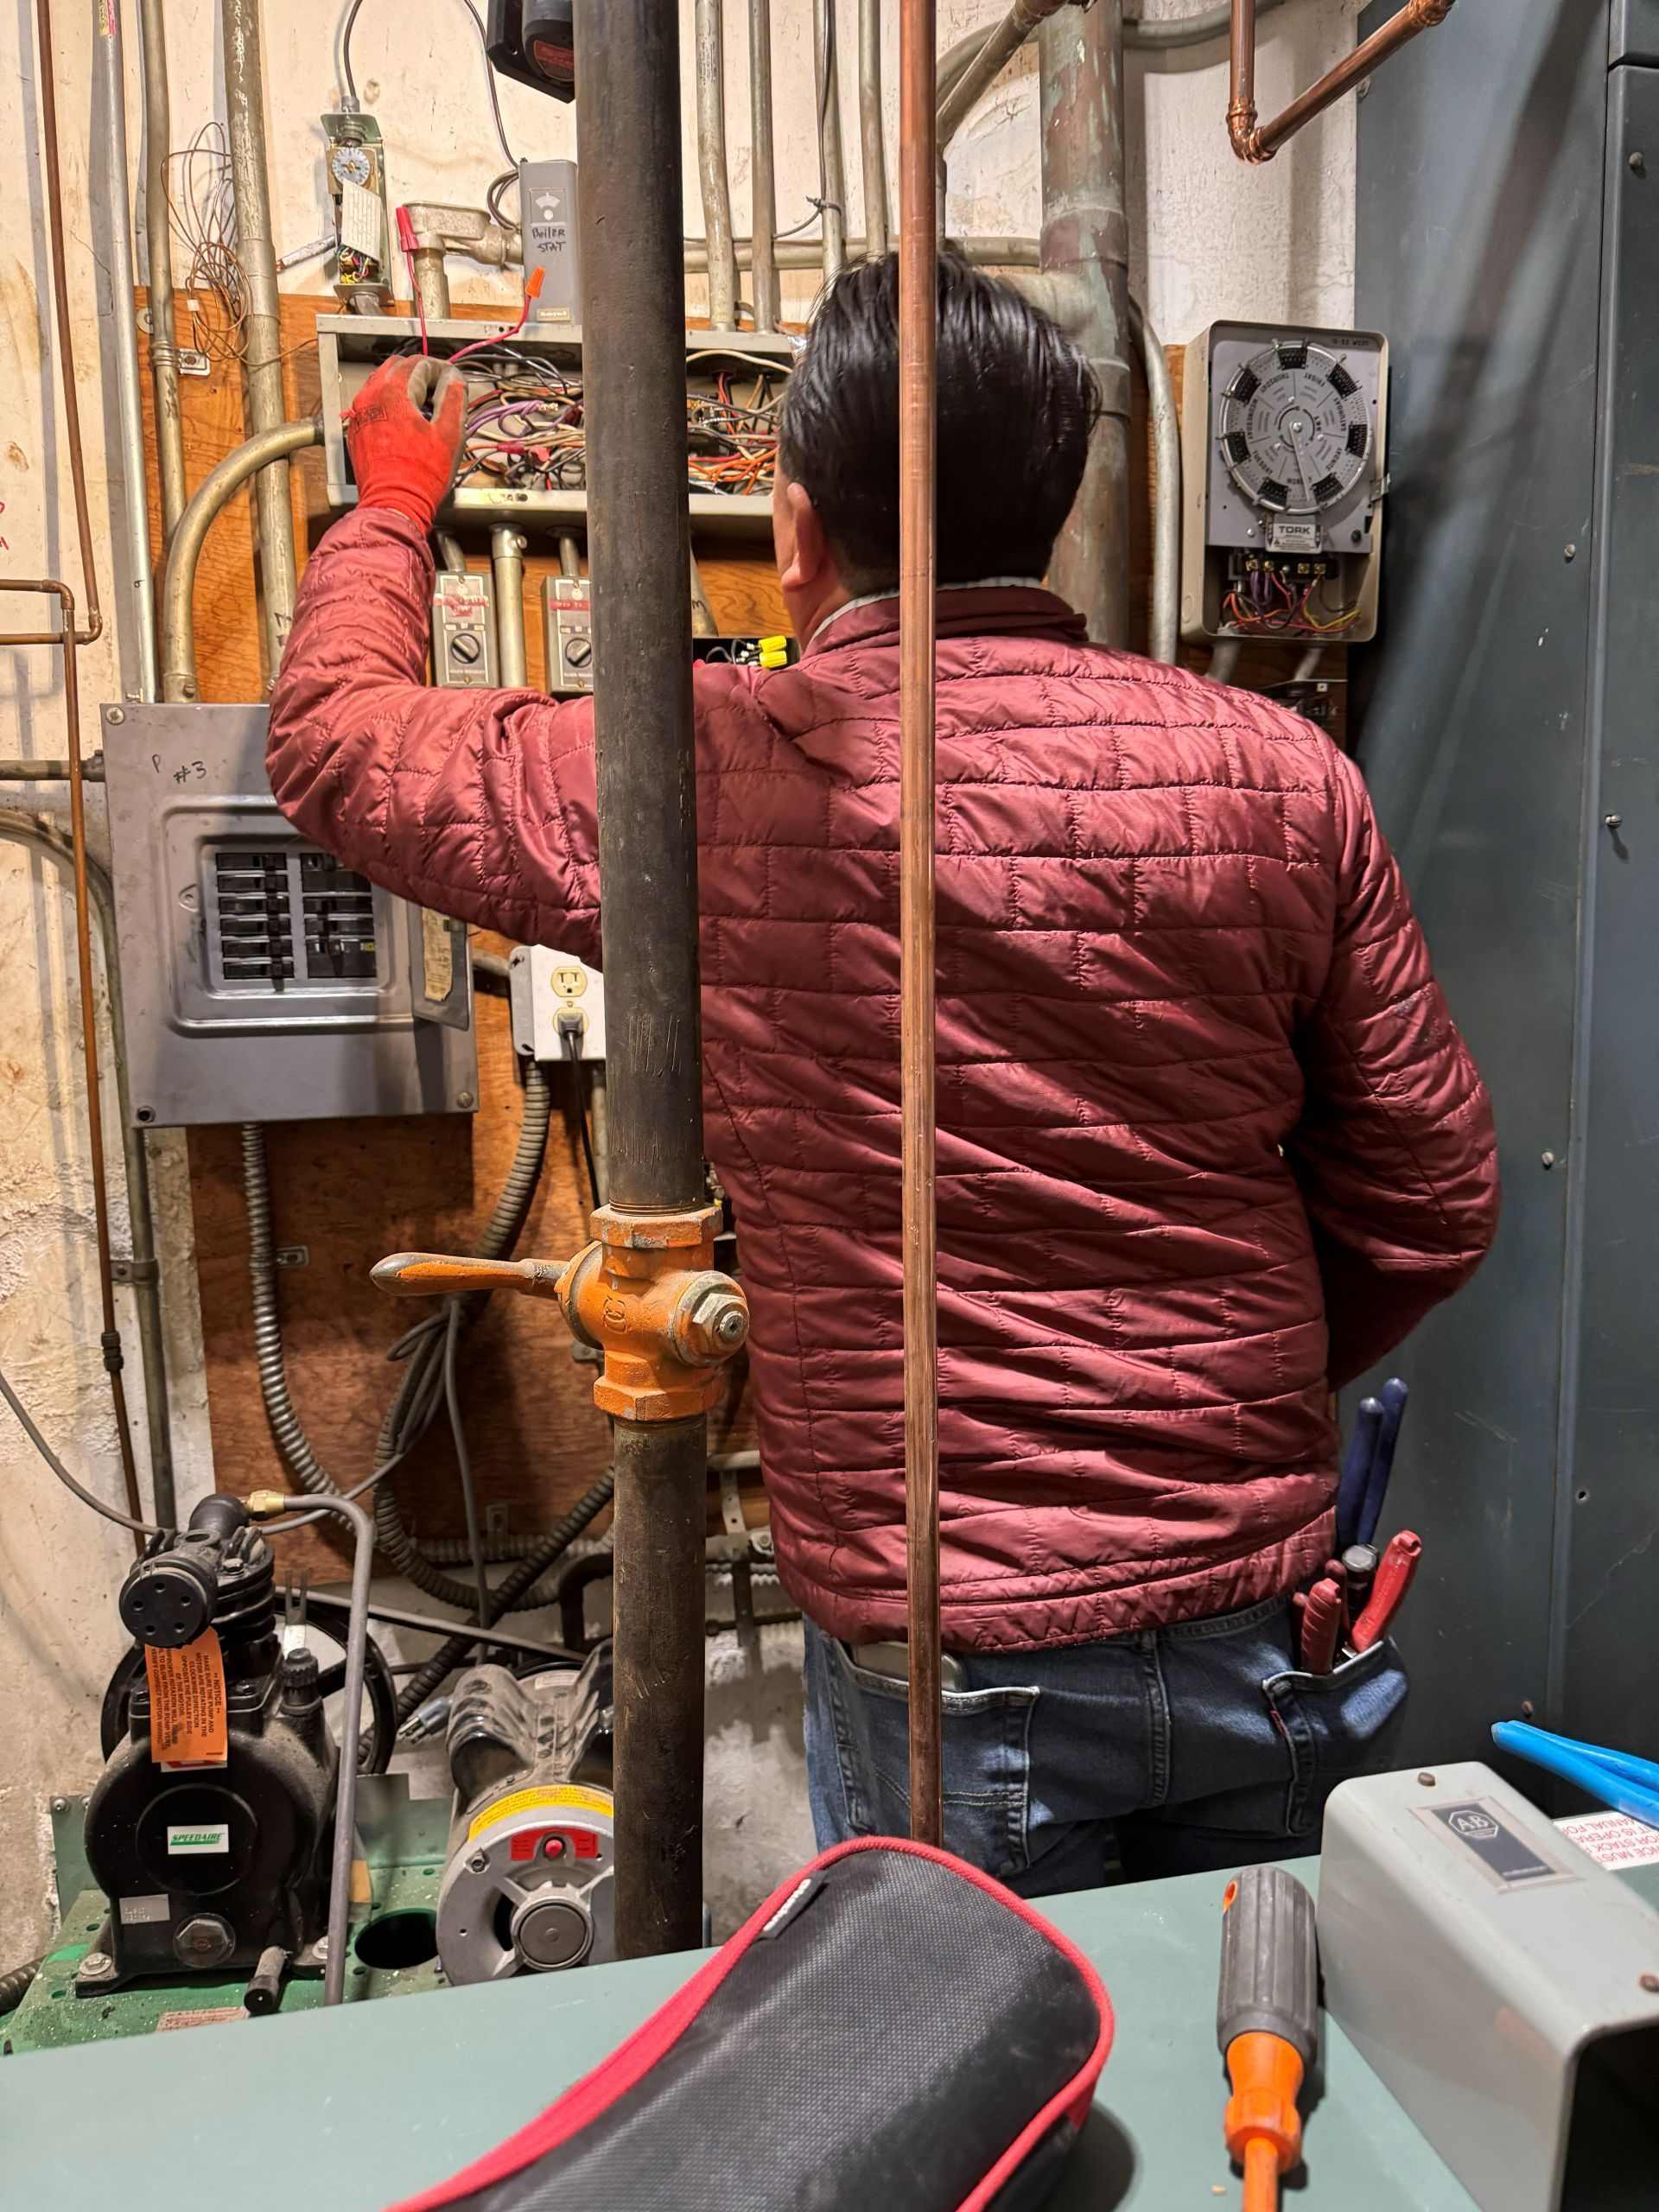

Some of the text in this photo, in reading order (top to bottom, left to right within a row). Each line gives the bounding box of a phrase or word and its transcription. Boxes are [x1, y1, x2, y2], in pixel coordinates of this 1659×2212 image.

[537, 241, 566, 252] STAT
[1303, 372, 1325, 388] FRIDAY
[1333, 397, 1347, 432] SATURDAY
[1279, 525, 1311, 534] TORK
[152, 753, 161, 773] P
[172, 1833, 222, 1841] SPEEDAIRE
[1621, 1827, 1637, 1836] IS
[1593, 1839, 1636, 1853] STACK
[1596, 1851, 1634, 1863] MUST
